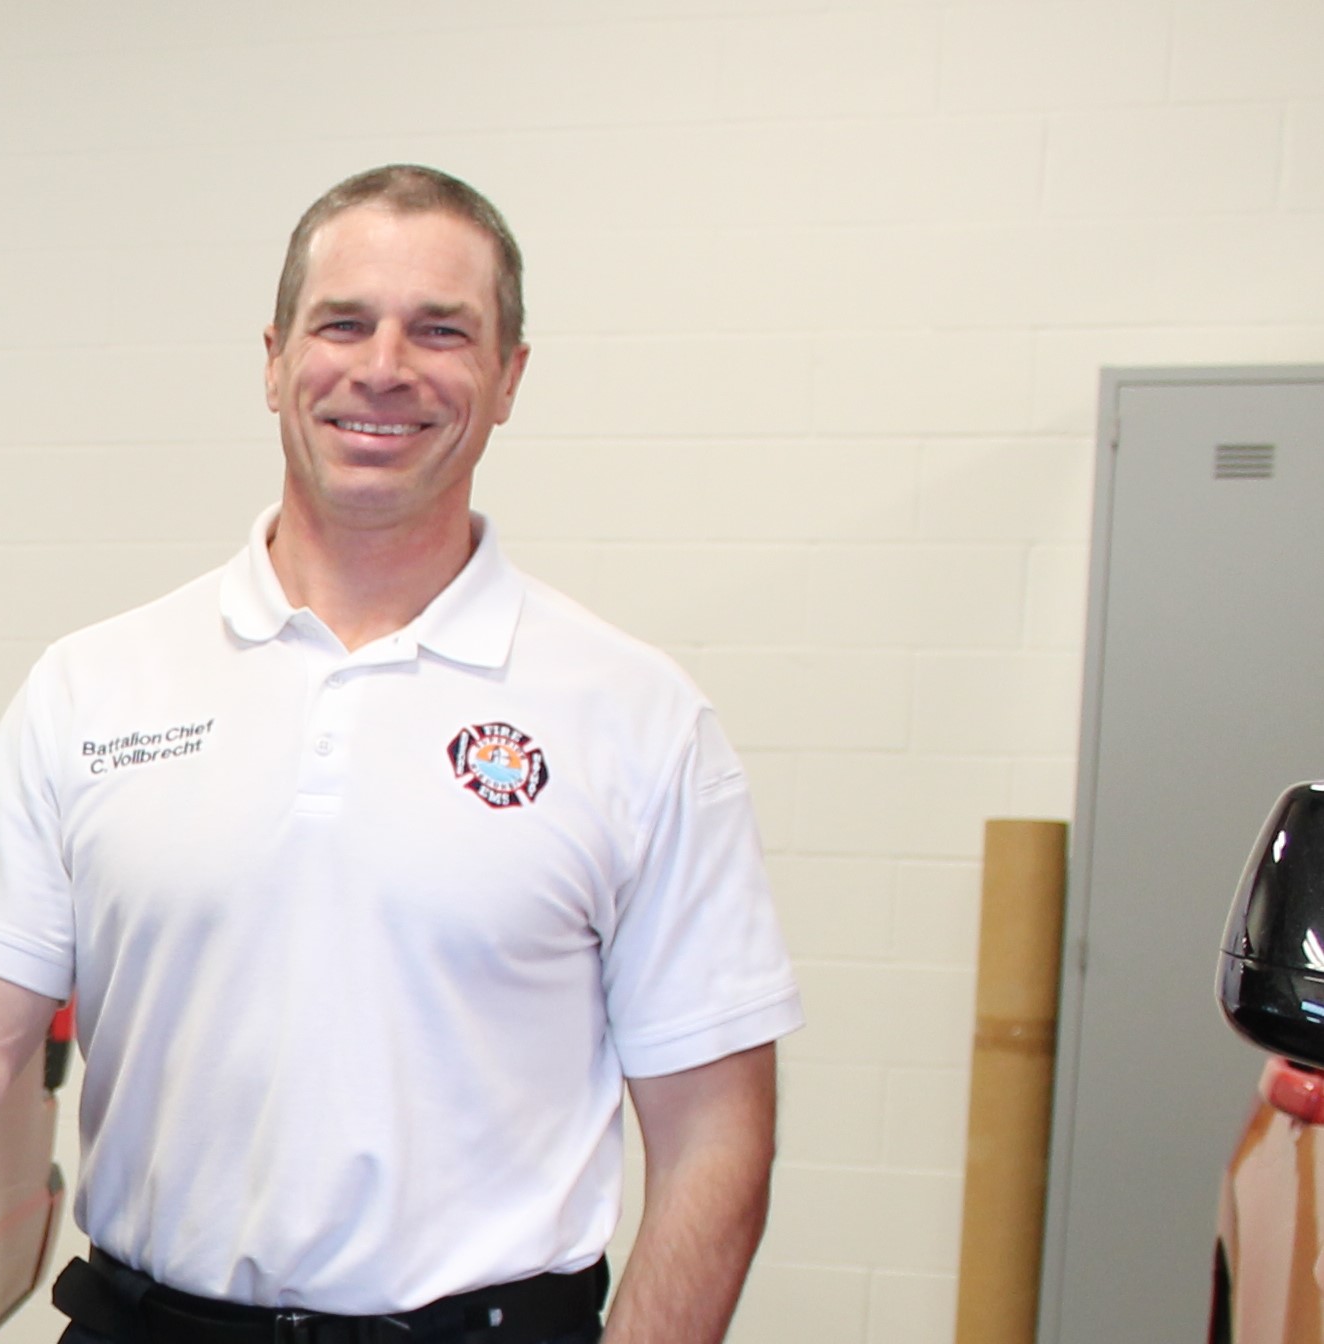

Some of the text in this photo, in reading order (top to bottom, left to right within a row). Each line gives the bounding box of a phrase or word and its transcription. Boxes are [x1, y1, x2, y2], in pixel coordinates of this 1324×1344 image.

[82, 719, 214, 756] Battalion Chief
[113, 740, 203, 769] Vollbrecht
